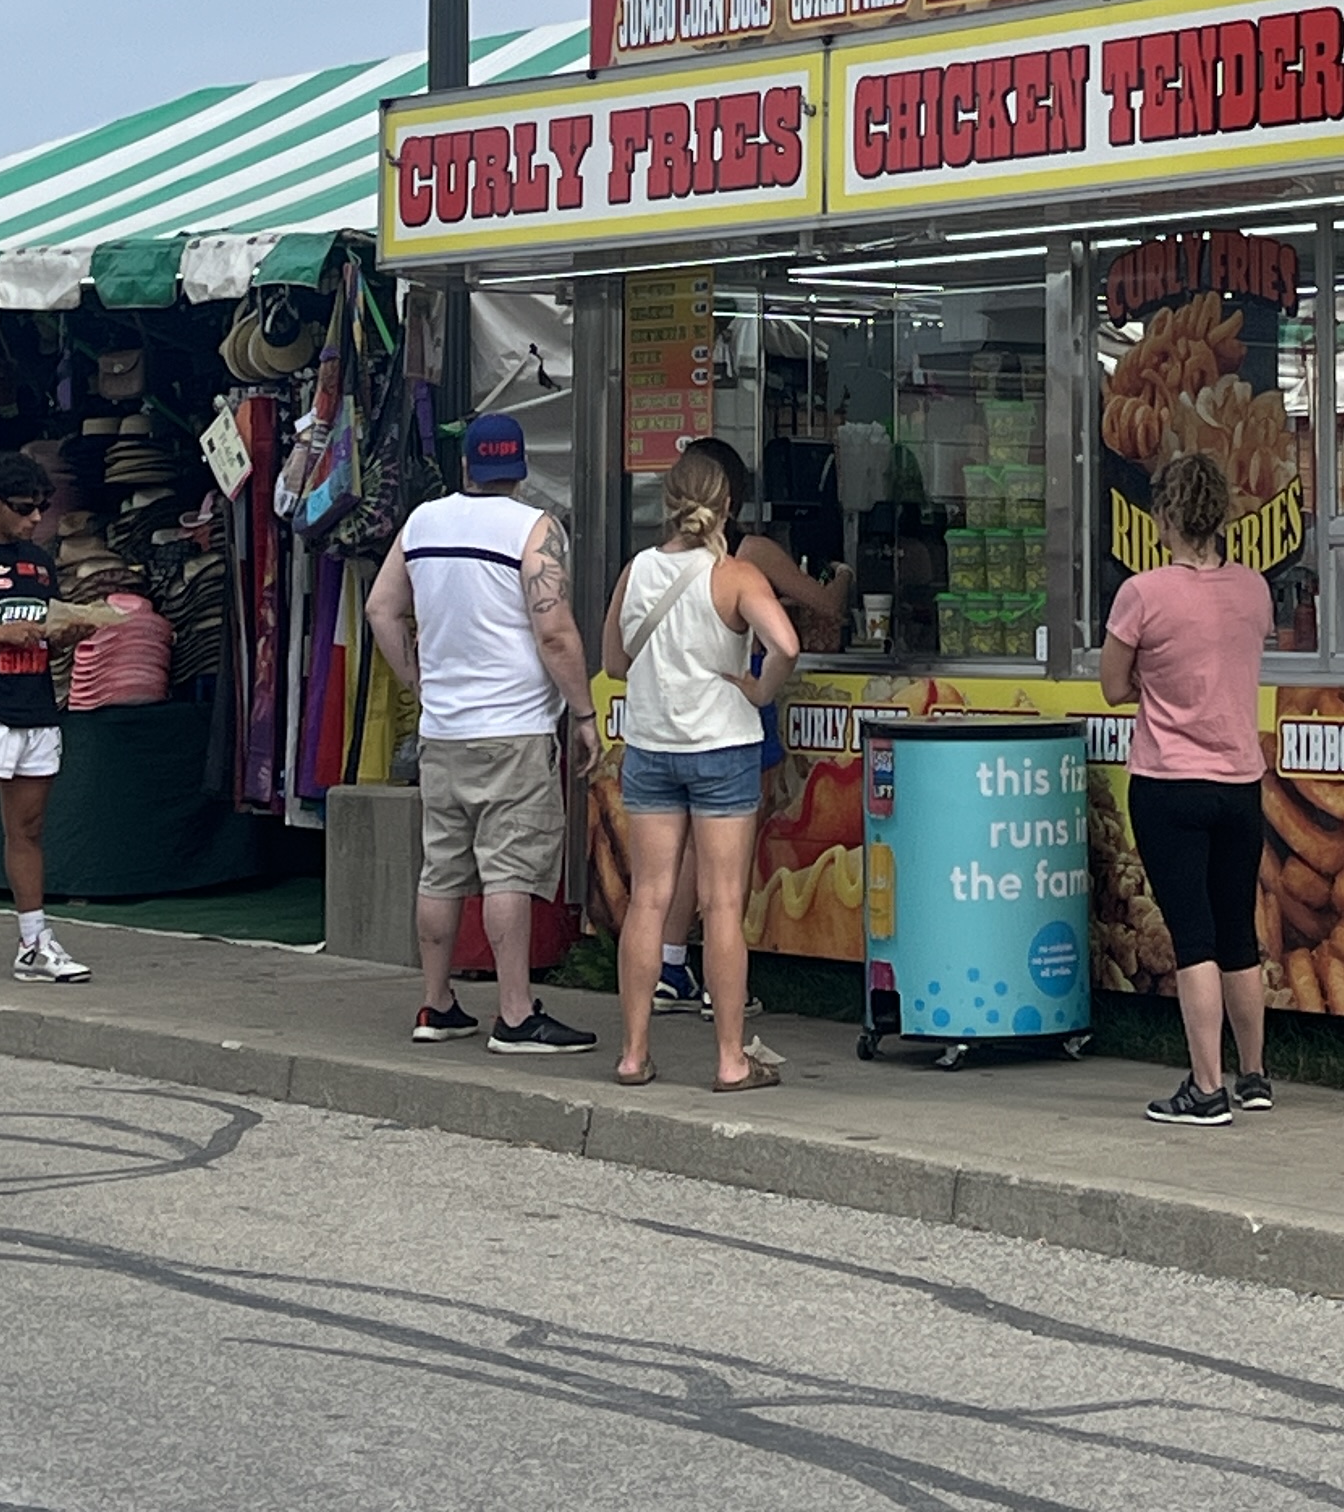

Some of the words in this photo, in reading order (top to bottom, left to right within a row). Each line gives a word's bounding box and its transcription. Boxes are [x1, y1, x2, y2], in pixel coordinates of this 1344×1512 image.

[854, 44, 1090, 179] CHICKEN
[398, 114, 594, 227] CURLY
[607, 85, 803, 205] FRIES
[1107, 234, 1202, 319] CURLY
[1211, 230, 1297, 309] FRIES
[789, 706, 848, 749] CURLY
[976, 756, 1050, 797] this
[990, 819, 1069, 849] runs
[949, 861, 1022, 902] the
